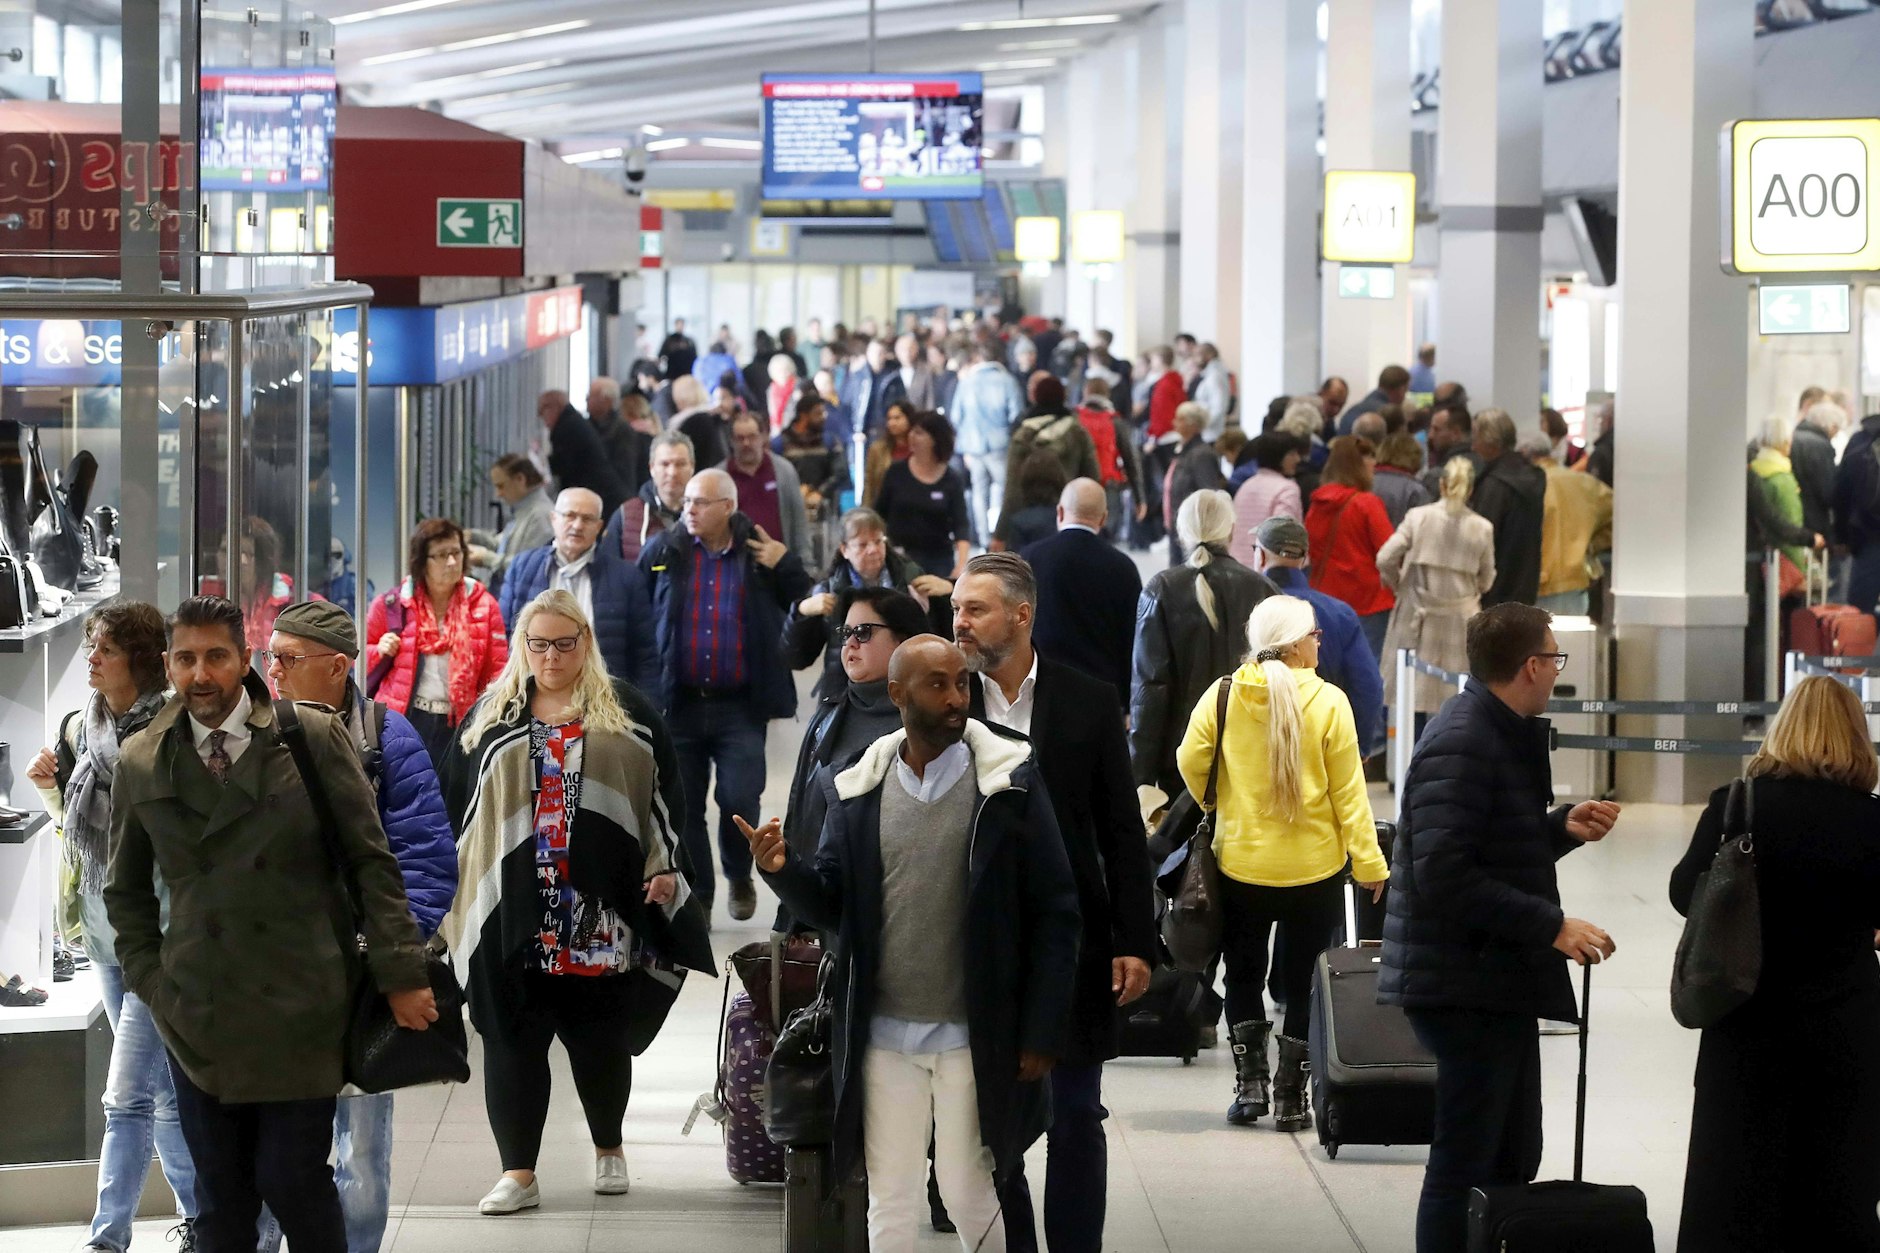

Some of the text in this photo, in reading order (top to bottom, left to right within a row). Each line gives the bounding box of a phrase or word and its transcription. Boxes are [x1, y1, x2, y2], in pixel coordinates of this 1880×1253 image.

[1758, 173, 1860, 218] A00
[1343, 204, 1395, 228] A01
[44, 327, 71, 364] &
[1823, 657, 1843, 667] BER
[1582, 701, 1604, 712] BER
[1716, 702, 1739, 713] BER
[1654, 739, 1677, 751] BER
